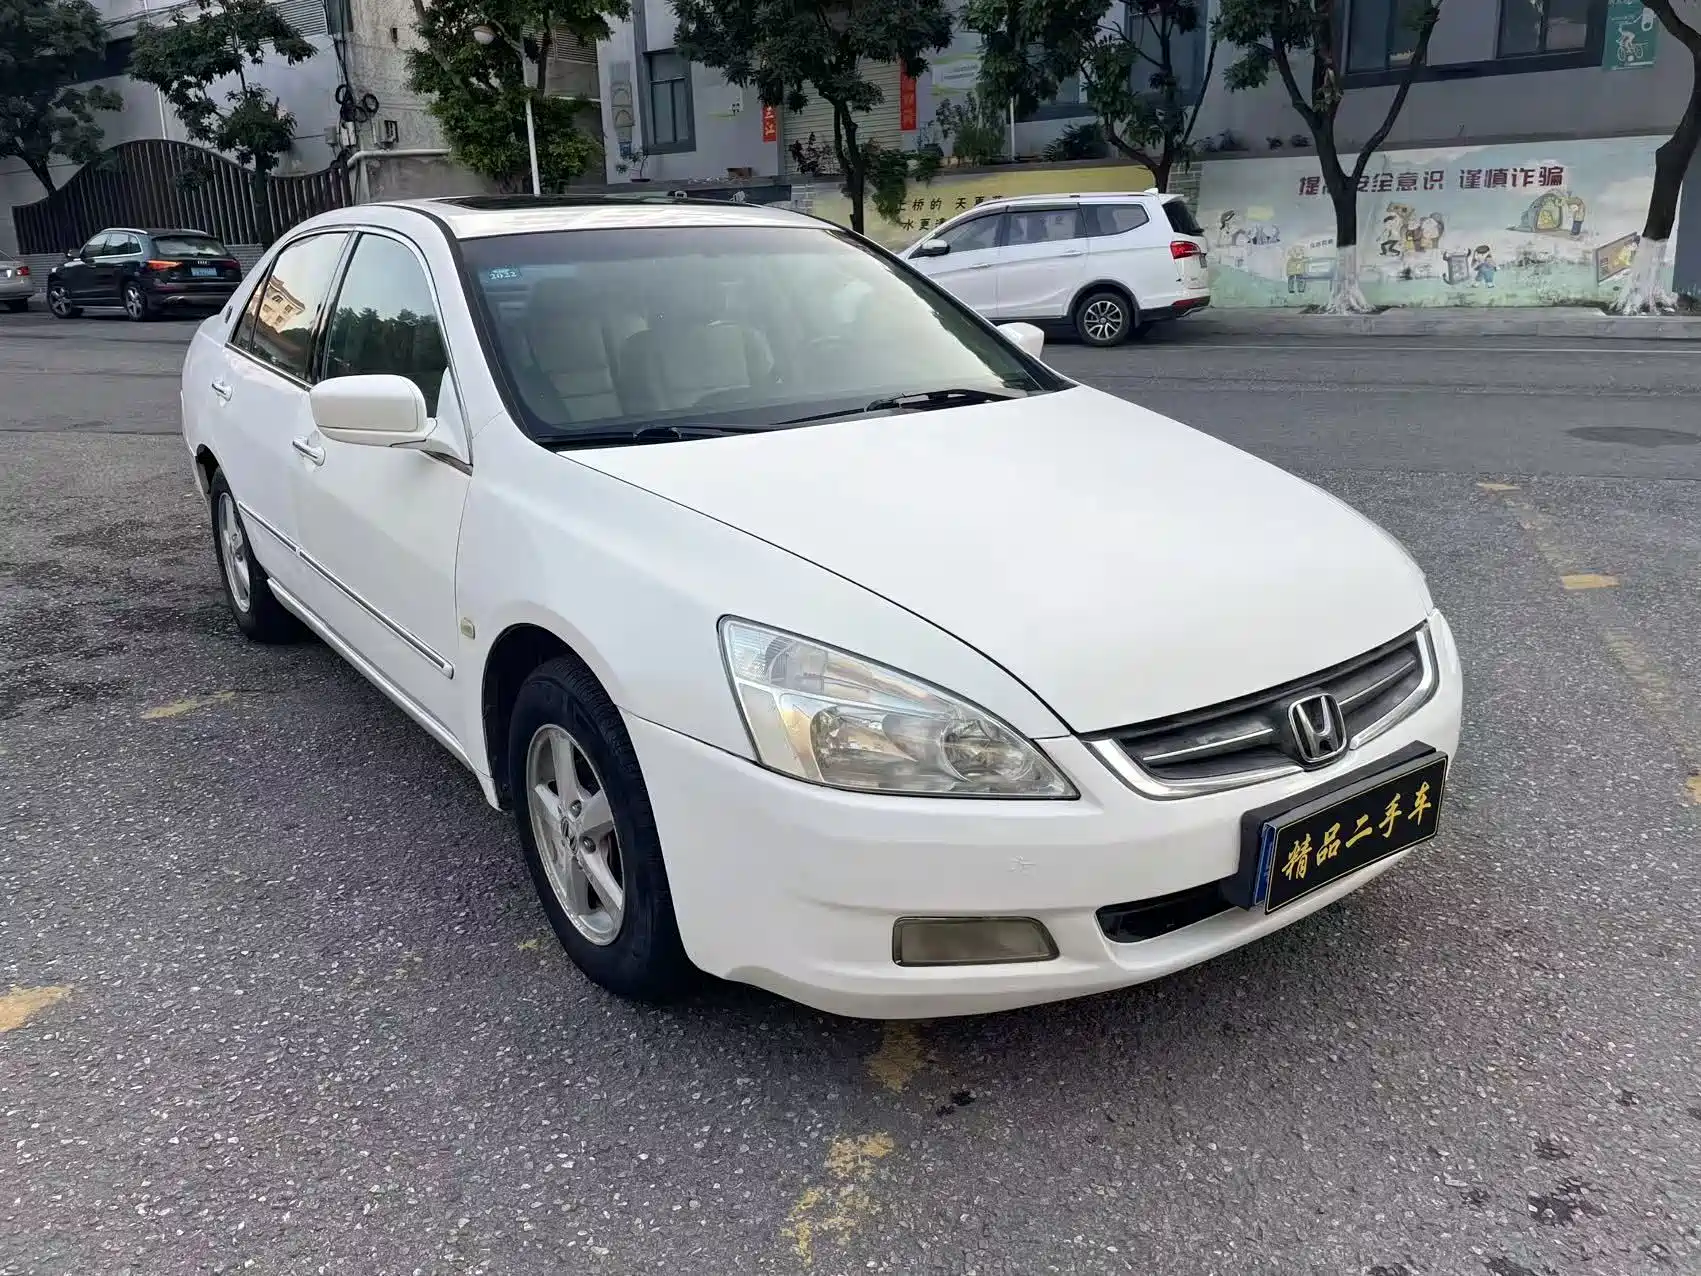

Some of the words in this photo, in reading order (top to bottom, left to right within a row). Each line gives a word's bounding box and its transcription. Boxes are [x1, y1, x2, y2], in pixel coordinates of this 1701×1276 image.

[1299, 170, 1445, 196] 提全意识
[1459, 166, 1564, 190] 谨慎诈骗
[954, 195, 1003, 210] 天更
[1281, 781, 1432, 881] 精品二手车
